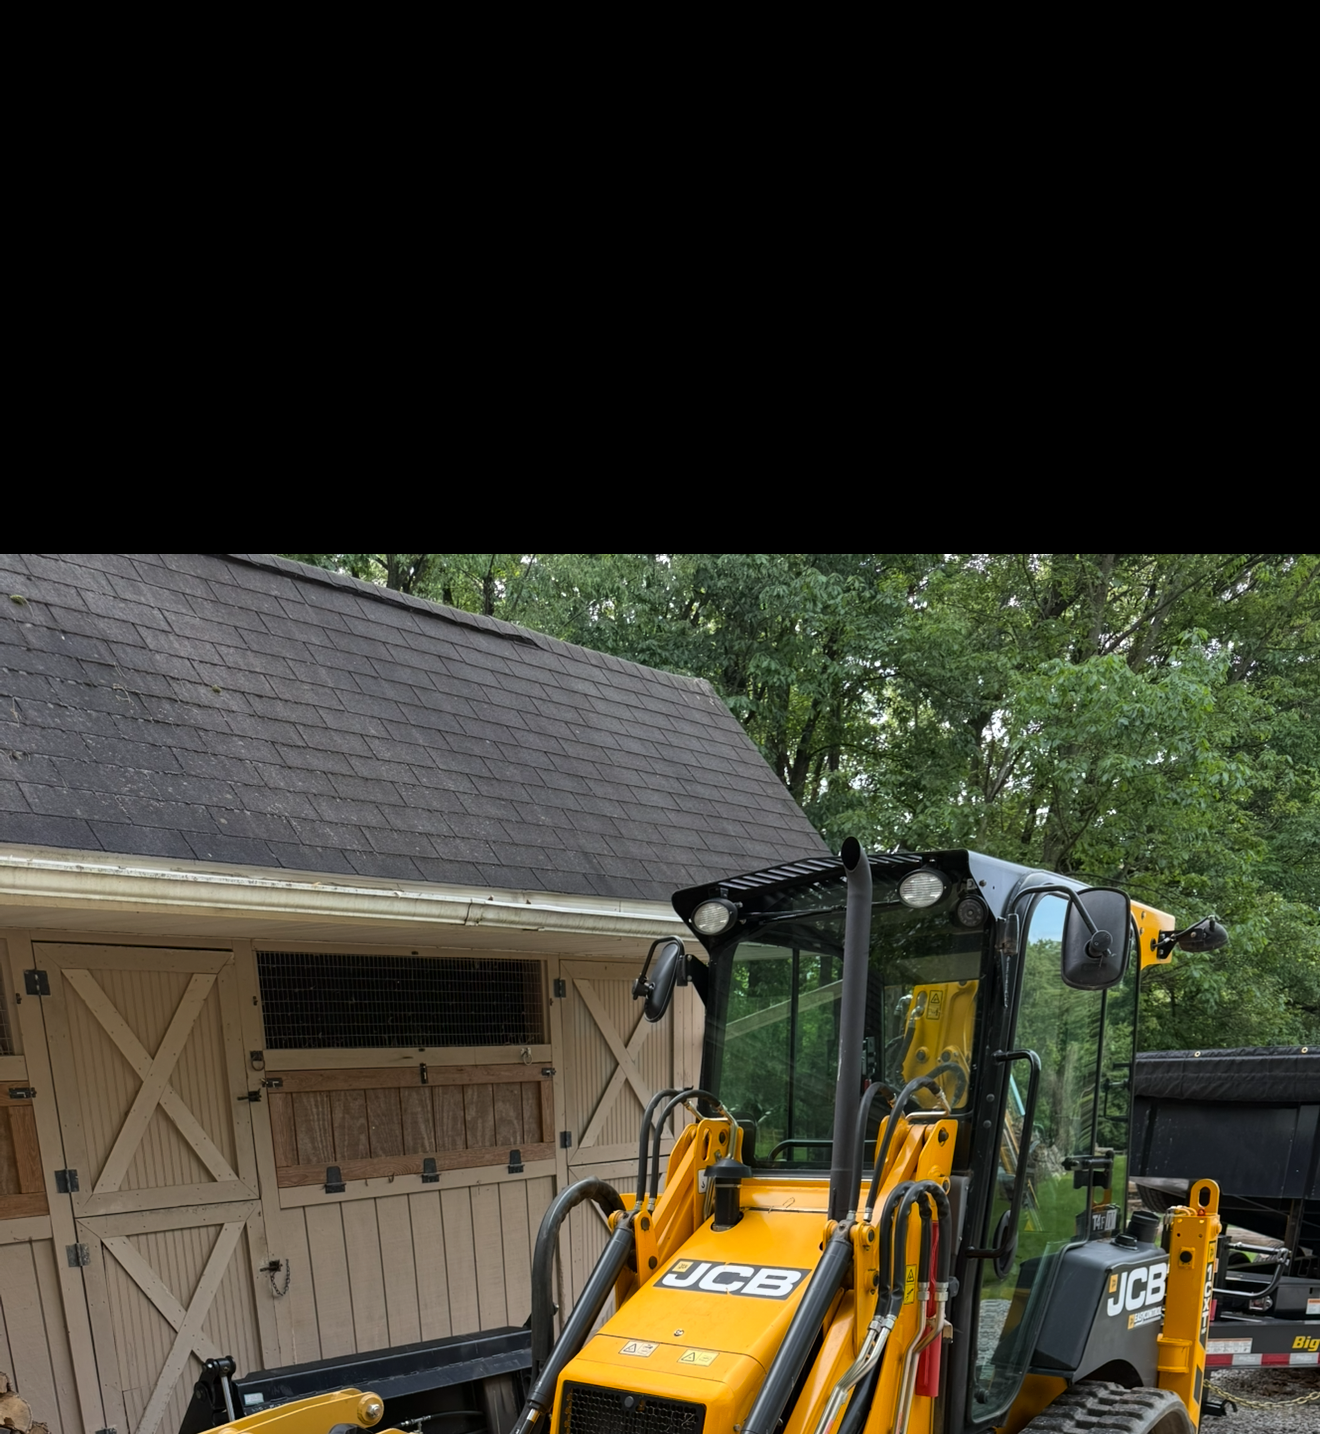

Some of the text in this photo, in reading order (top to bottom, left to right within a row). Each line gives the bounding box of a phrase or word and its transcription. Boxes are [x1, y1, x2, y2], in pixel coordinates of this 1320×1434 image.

[662, 1262, 802, 1297] JCB
[1107, 1263, 1167, 1317] JCB
[1292, 1336, 1320, 1352] Big
